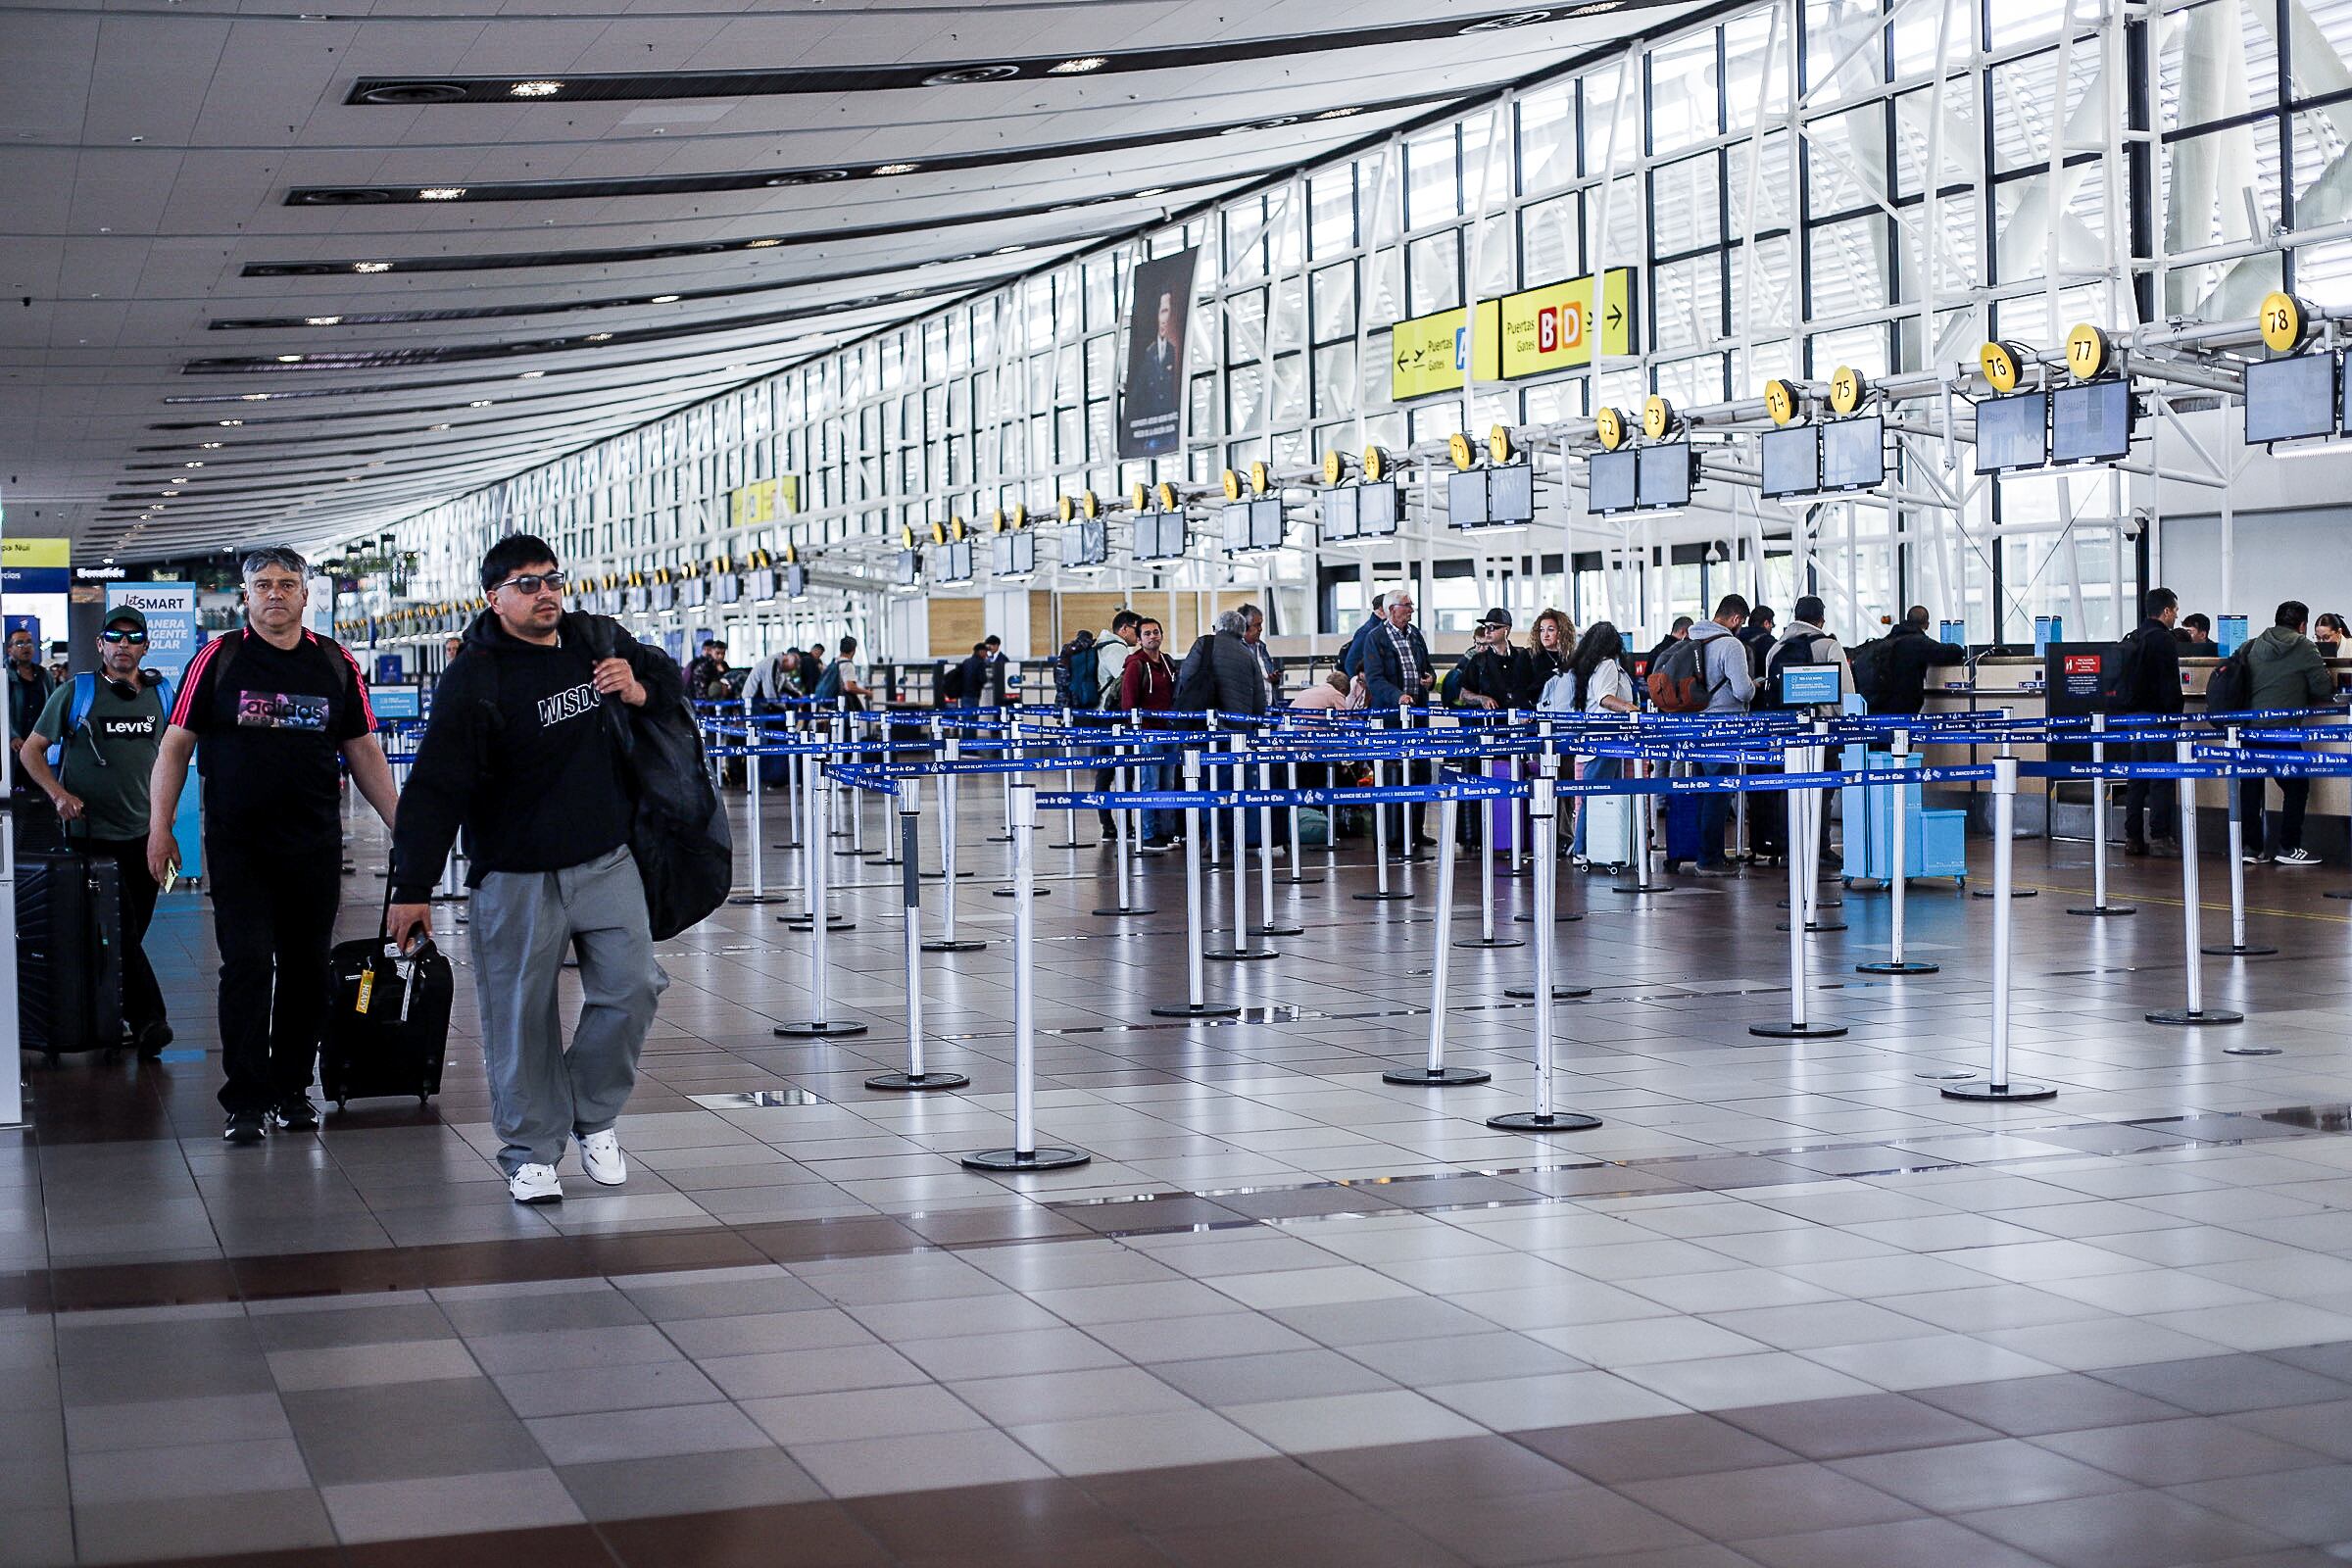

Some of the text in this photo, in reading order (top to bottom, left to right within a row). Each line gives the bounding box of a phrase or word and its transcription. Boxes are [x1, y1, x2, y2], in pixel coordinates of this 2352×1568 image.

[1506, 320, 1536, 335] Puertas
[1541, 307, 1580, 349] B D
[2267, 309, 2289, 333] 78
[1427, 338, 1453, 352] Puertas
[1516, 340, 1536, 353] Gates
[2074, 340, 2092, 362] 77
[1986, 357, 2007, 378] 76
[1836, 379, 1850, 400] 75
[1769, 392, 1785, 414] 74
[1647, 409, 1660, 425] 73
[1601, 419, 1615, 436] 72
[146, 619, 185, 629] ANERA
[149, 639, 181, 650] OLAR
[246, 693, 324, 718] adidas
[1464, 787, 1481, 795] Banco
[1487, 786, 1501, 795] Chile
[1057, 796, 1072, 804] Chile
